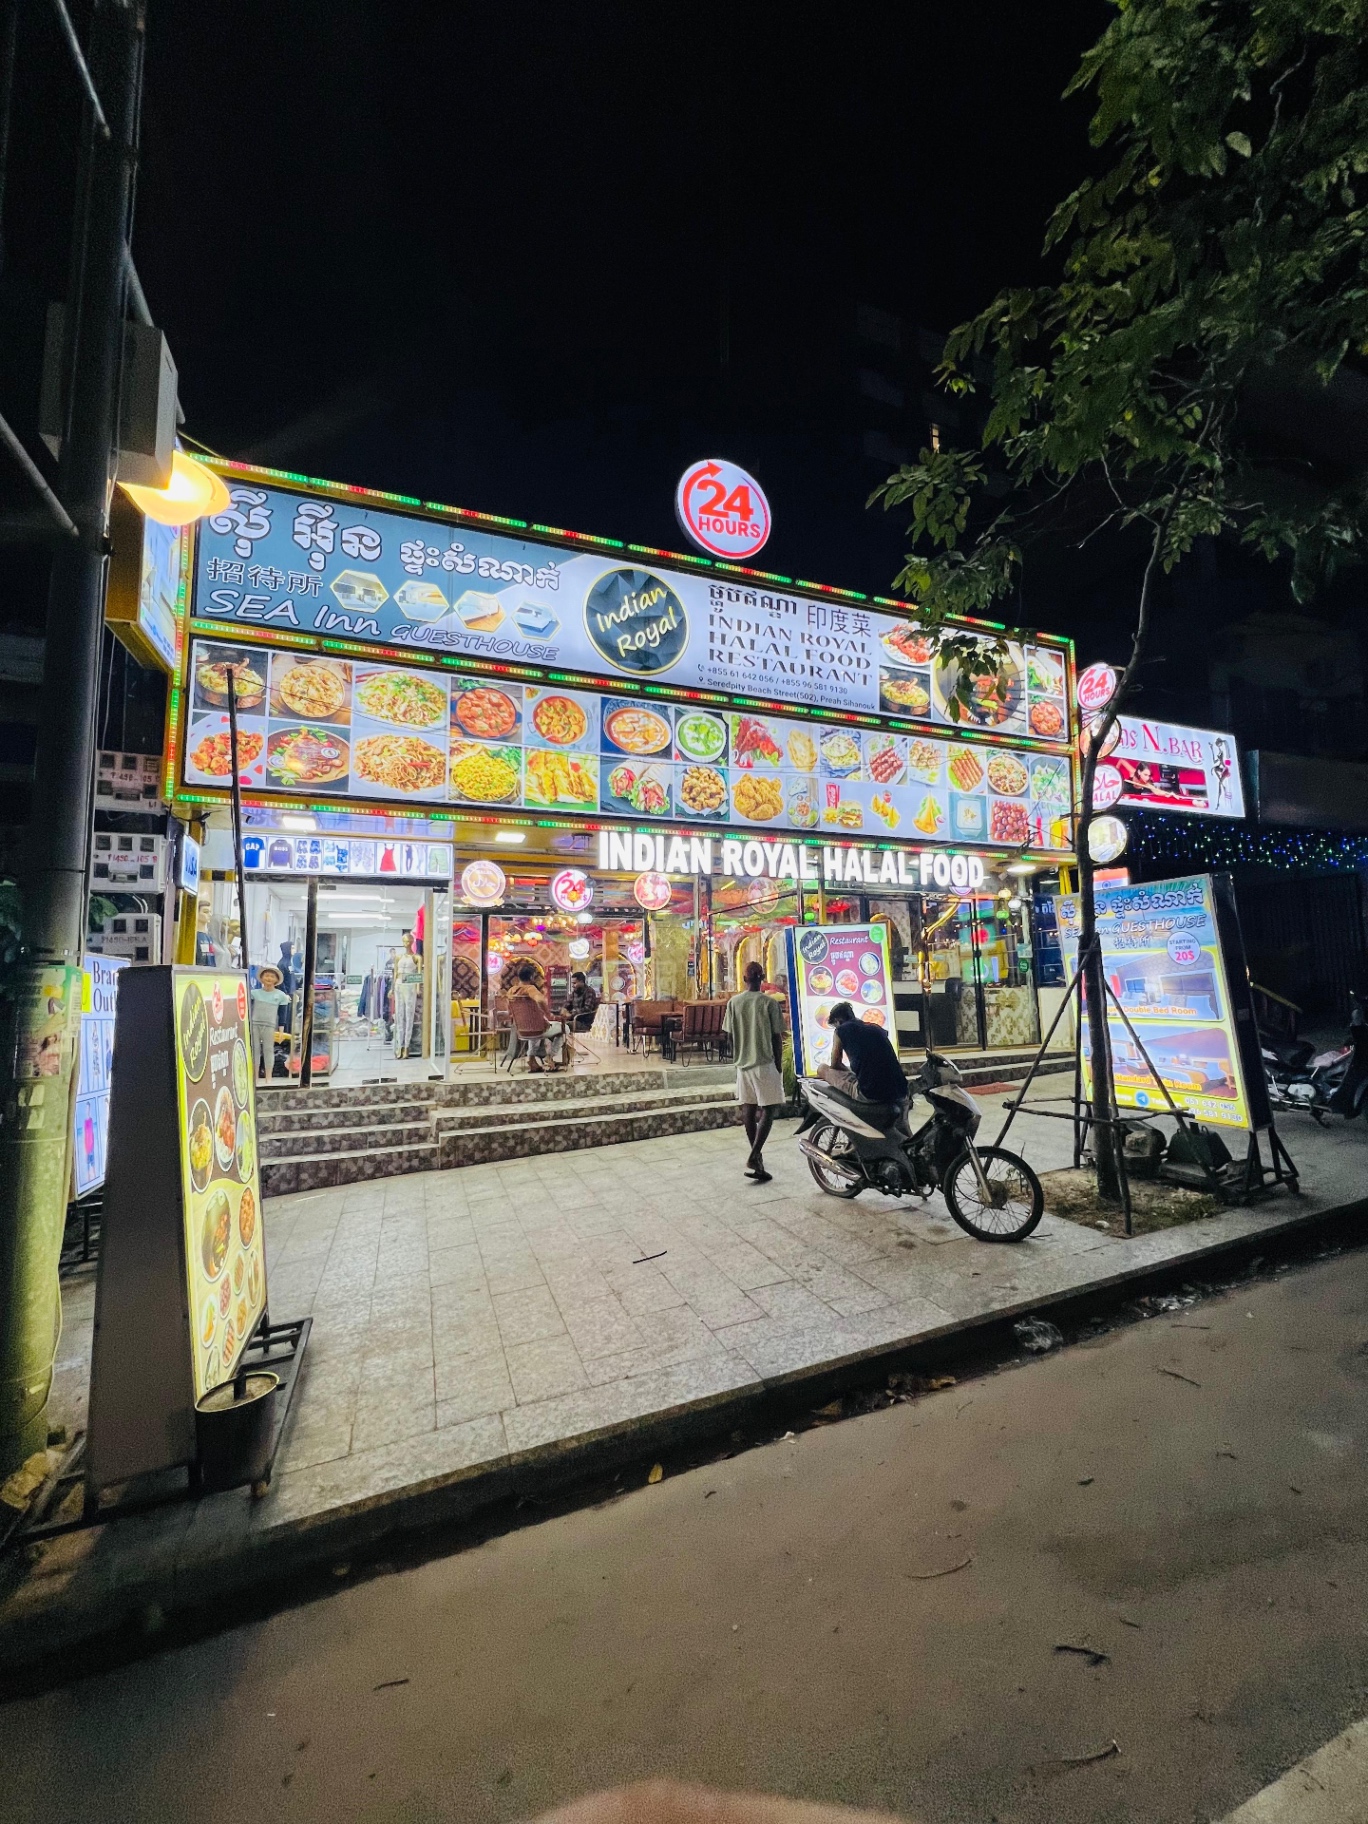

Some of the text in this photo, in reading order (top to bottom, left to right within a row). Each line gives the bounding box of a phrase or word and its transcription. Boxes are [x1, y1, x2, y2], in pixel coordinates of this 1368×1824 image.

[696, 479, 754, 522] 24
[698, 516, 761, 539] HOURS
[207, 557, 324, 597] 招待所
[596, 587, 667, 633] Indian
[807, 604, 872, 637] 印度菜
[204, 588, 560, 661] SEA Inn GUESTHOUSE
[617, 605, 678, 658] Royal
[708, 614, 872, 656] INDIAN ROYAL
[709, 631, 871, 670] HALAL FOOD
[709, 648, 873, 686] RESTAURANT
[707, 666, 728, 676] +855
[729, 669, 739, 678] 61
[742, 672, 757, 682] 642
[758, 675, 774, 684] 056
[781, 677, 801, 688] +855
[802, 680, 813, 689] 96
[814, 682, 828, 691] 581
[829, 685, 848, 695] 9130
[1083, 671, 1108, 694] 24
[747, 682, 772, 695] Beach
[774, 687, 819, 703] Street(502),
[820, 696, 843, 706] Preah
[843, 699, 876, 711] Sihanouk
[1084, 687, 1111, 702] HOURS
[1093, 790, 1117, 802] ALAL
[245, 843, 260, 851] GAP
[598, 831, 986, 889] INDIAN ROYAL HALAL FOOD
[561, 879, 586, 894] 24
[1111, 914, 1207, 935] GUESTHOUSE
[802, 934, 822, 953] Indian
[808, 940, 826, 960] Royal
[830, 936, 869, 945] Restaurant
[1175, 950, 1195, 961] 20$
[1124, 1006, 1151, 1014] Double
[1153, 1006, 1169, 1014] Bed
[1171, 1006, 1197, 1015] Room
